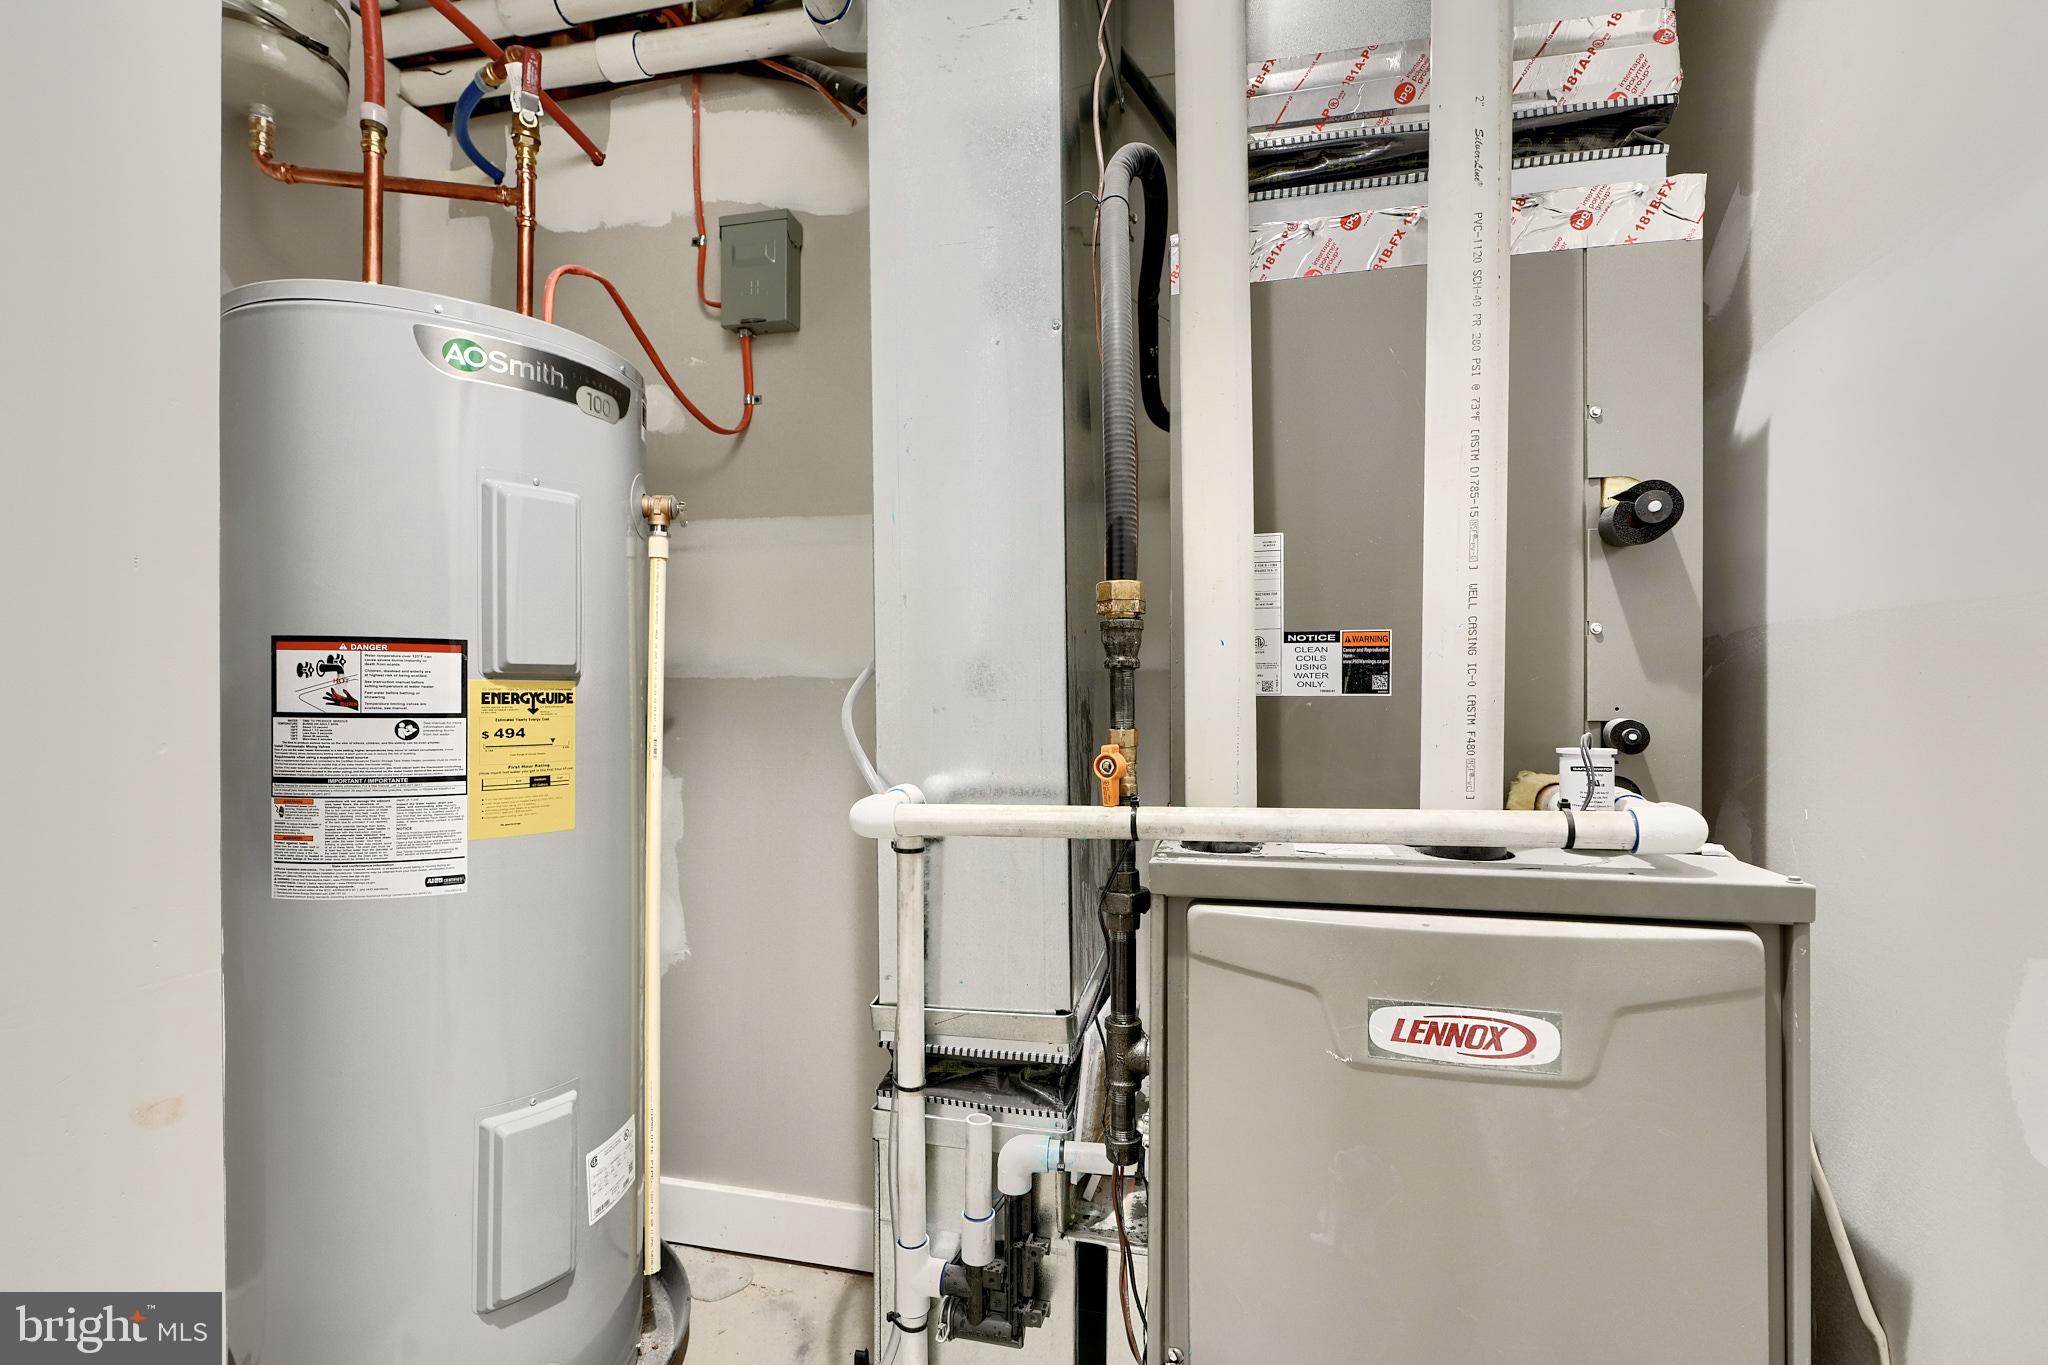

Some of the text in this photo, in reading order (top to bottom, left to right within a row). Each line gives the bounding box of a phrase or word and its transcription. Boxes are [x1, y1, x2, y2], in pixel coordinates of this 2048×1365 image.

[1618, 53, 1644, 88] intertape
[1625, 57, 1649, 92] polymer
[1395, 84, 1414, 104] ipg
[1588, 184, 1607, 210] polyme
[1636, 179, 1677, 232] 181B-FX
[1472, 212, 1483, 264] PVC-1120
[1312, 238, 1333, 266] intertape
[1319, 242, 1338, 270] polymer
[1472, 269, 1482, 307] SCH-40
[1471, 313, 1482, 327] PR
[1471, 332, 1481, 352] 280
[1471, 357, 1481, 377] PSI
[1471, 383, 1480, 391] @
[587, 392, 611, 417] 100
[1469, 466, 1479, 518] D1785-15
[1468, 583, 1478, 610] WELL
[1287, 633, 1336, 642] NOTICE
[1351, 635, 1389, 643] WARNING
[1467, 615, 1477, 656] CASING
[481, 691, 574, 705] ENERGYGUIDE
[481, 727, 526, 740] $ 494
[1466, 731, 1476, 756] F480
[1390, 1018, 1510, 1052] LENNOX
